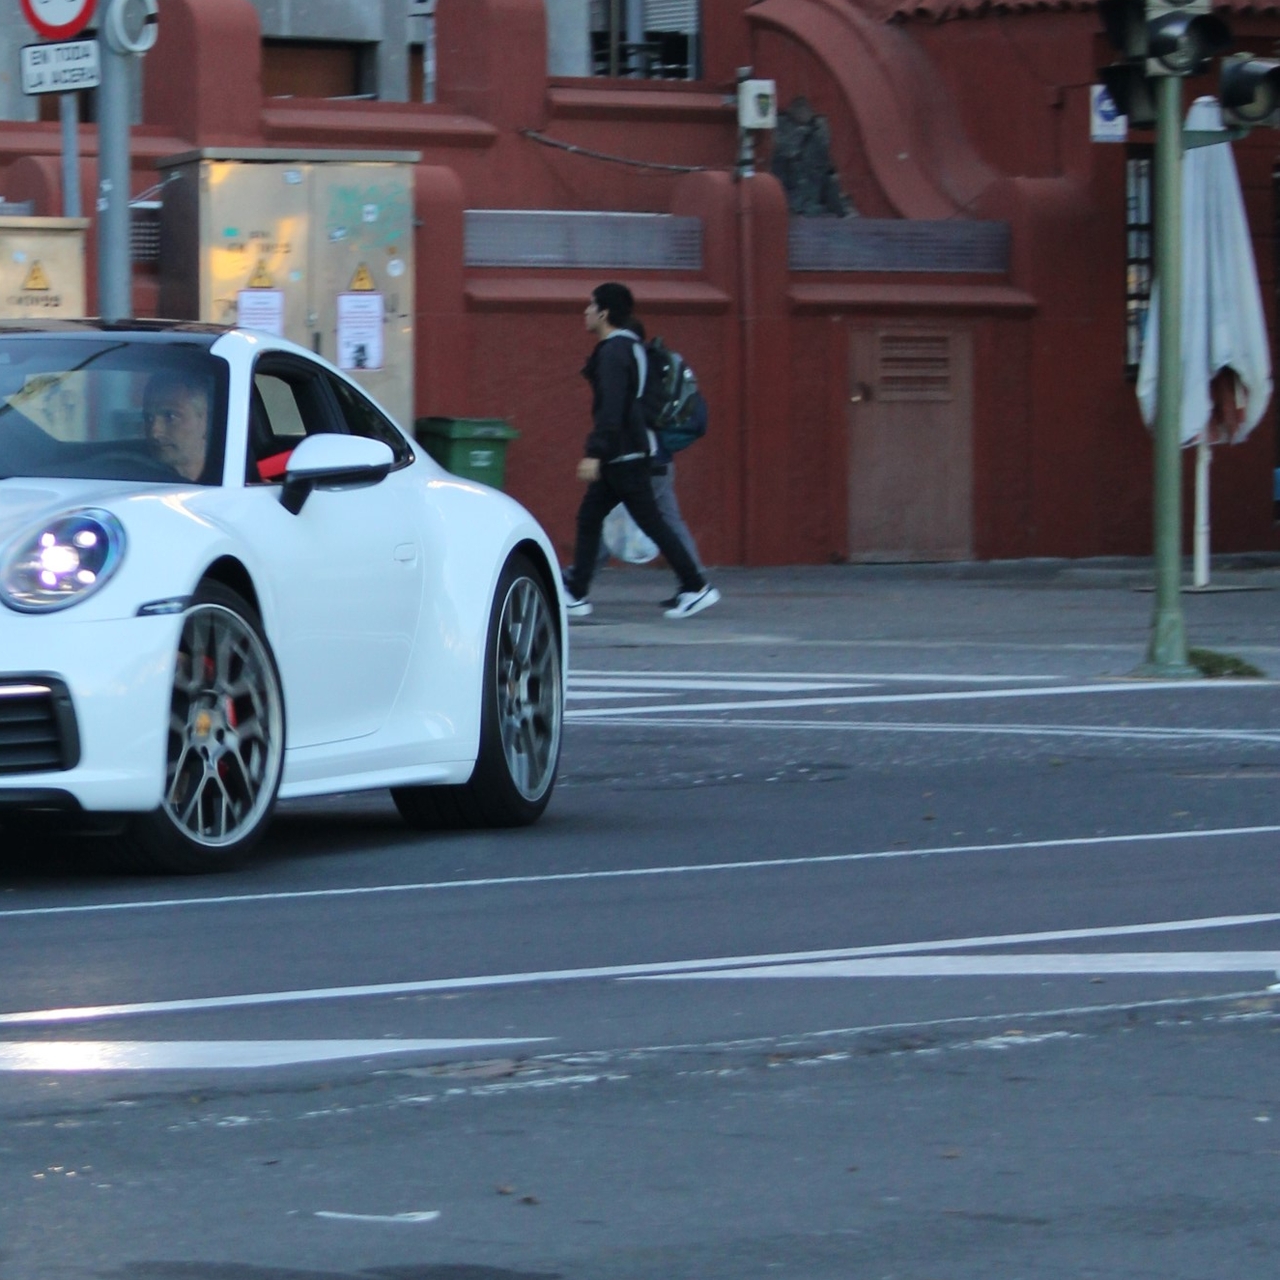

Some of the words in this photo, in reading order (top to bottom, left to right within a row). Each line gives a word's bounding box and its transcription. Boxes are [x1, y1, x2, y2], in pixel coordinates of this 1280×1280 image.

[31, 48, 51, 66] EN
[55, 44, 91, 62] TODA
[27, 70, 45, 89] LA
[51, 66, 98, 84] ACERA
